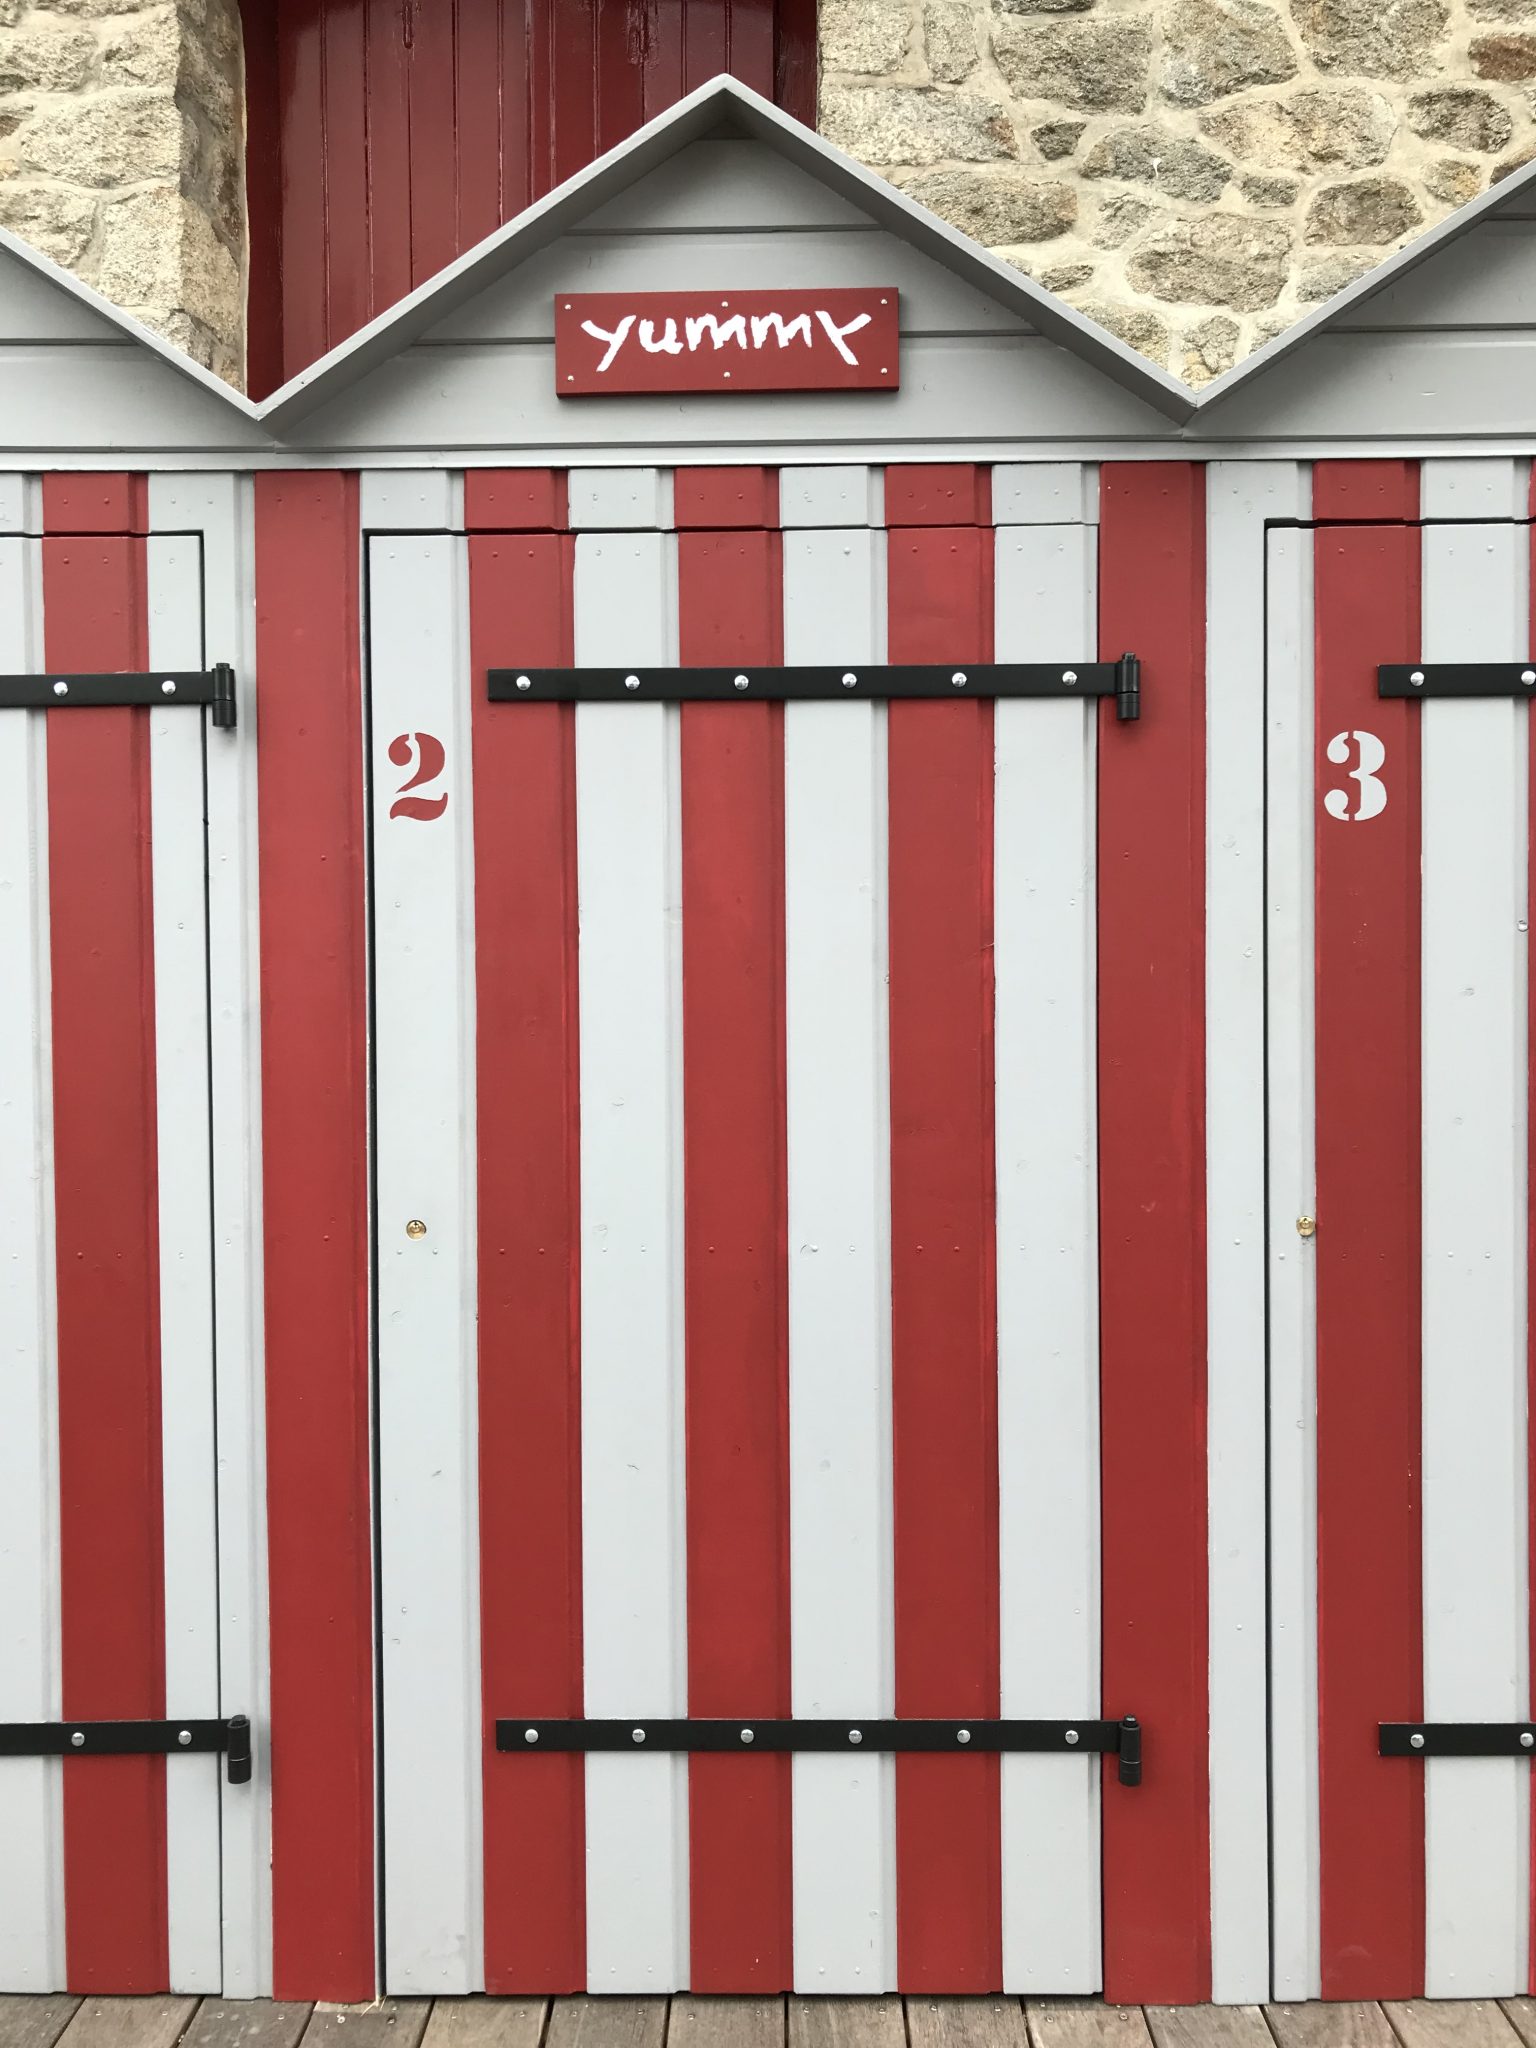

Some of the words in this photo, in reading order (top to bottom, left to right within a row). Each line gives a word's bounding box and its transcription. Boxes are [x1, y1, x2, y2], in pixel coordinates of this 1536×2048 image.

[580, 310, 872, 372] yummy
[388, 732, 448, 821] 2
[1324, 730, 1387, 821] 3
